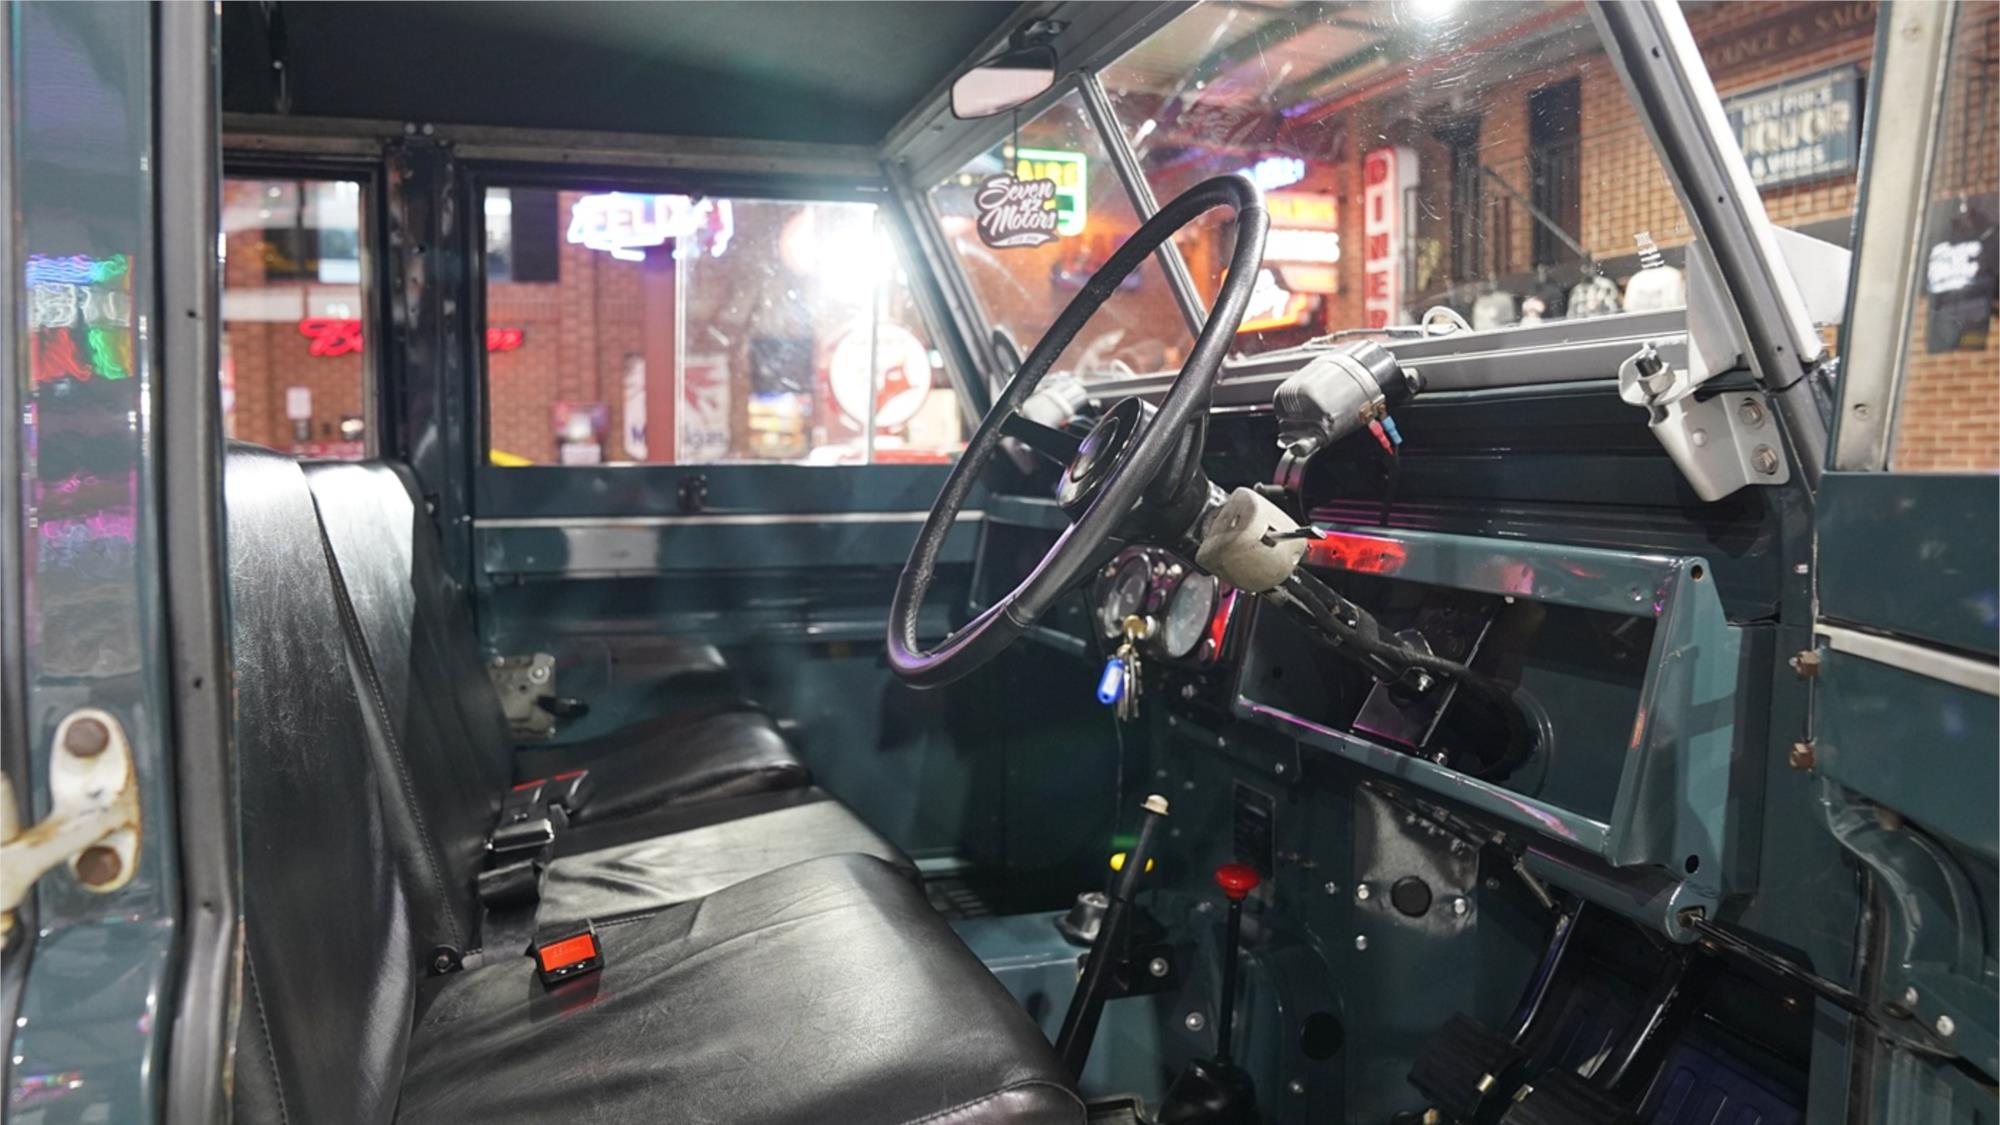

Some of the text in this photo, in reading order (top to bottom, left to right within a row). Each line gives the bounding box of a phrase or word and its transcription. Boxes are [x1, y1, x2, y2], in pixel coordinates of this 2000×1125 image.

[979, 177, 1052, 209] Seven
[981, 205, 1056, 236] Motors
[1366, 157, 1388, 330] DINER
